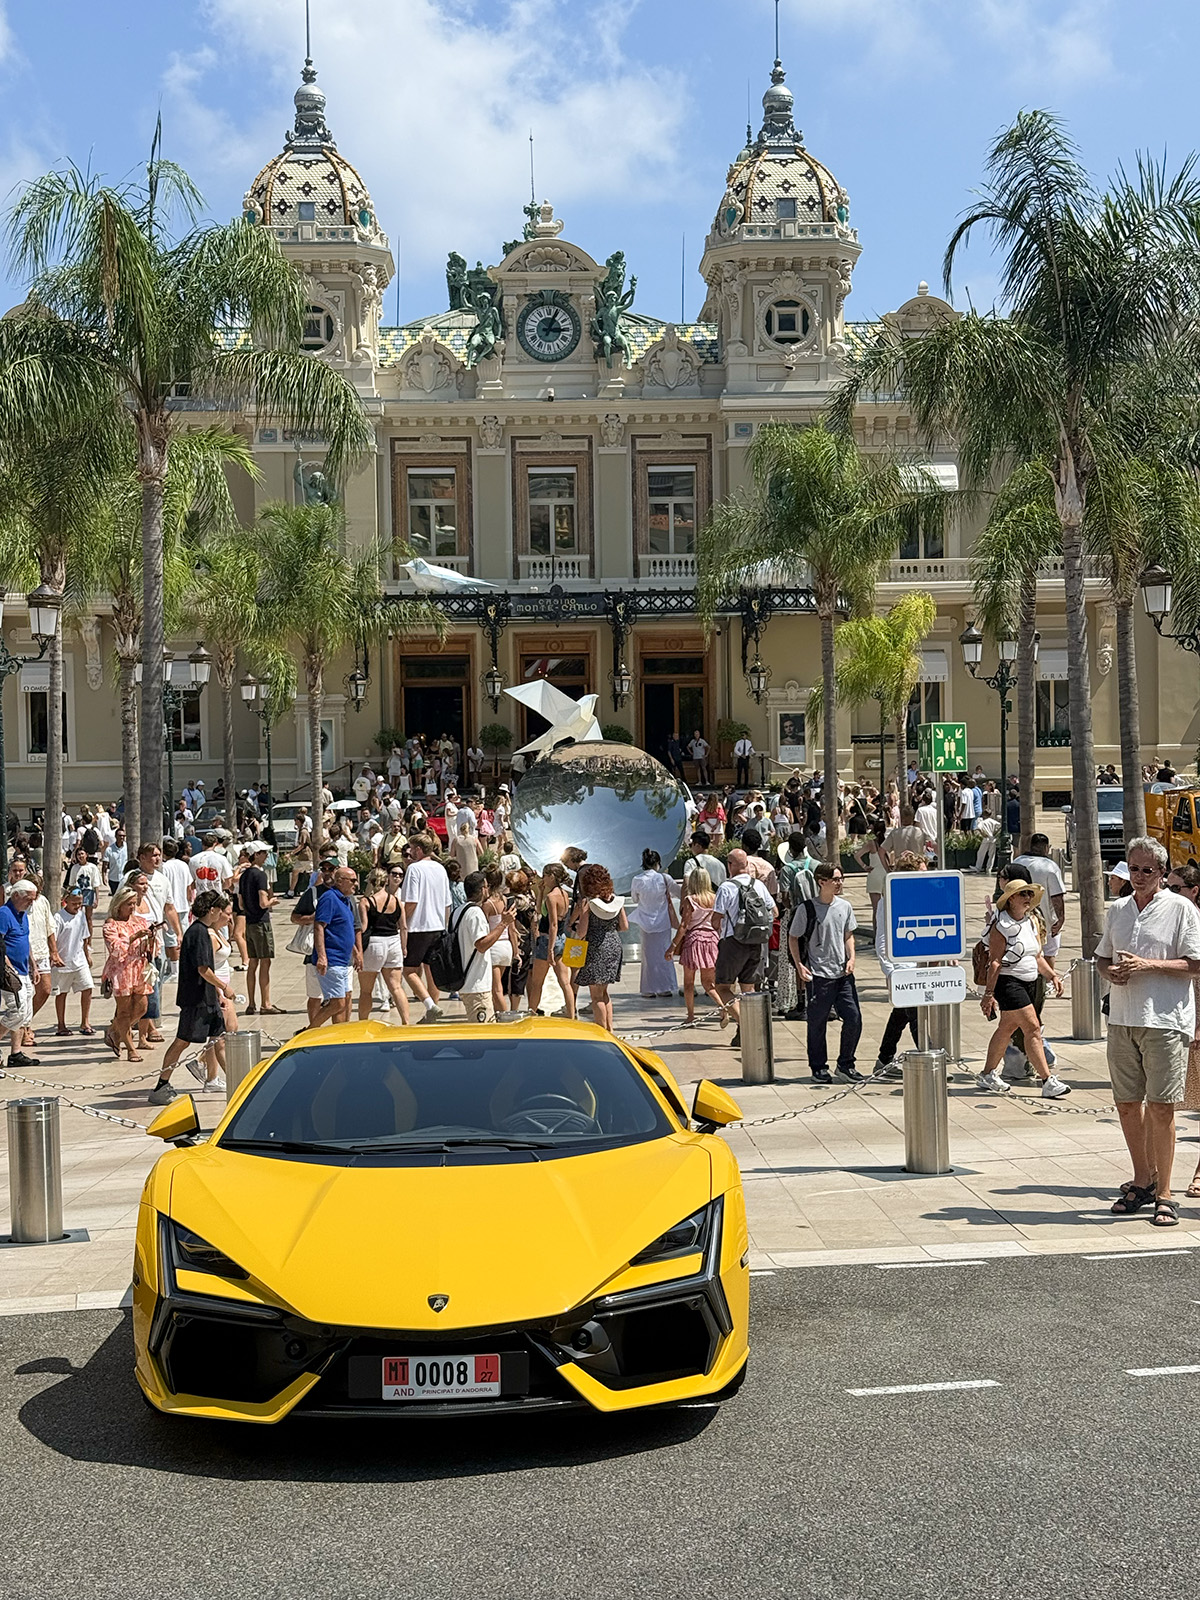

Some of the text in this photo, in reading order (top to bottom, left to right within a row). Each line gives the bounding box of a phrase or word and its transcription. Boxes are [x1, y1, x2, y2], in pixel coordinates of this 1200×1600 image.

[895, 979, 962, 991] NAVETTE SHUTTLE
[388, 1361, 468, 1387] MT 0008
[480, 1371, 493, 1382] 27
[393, 1388, 415, 1397] AND
